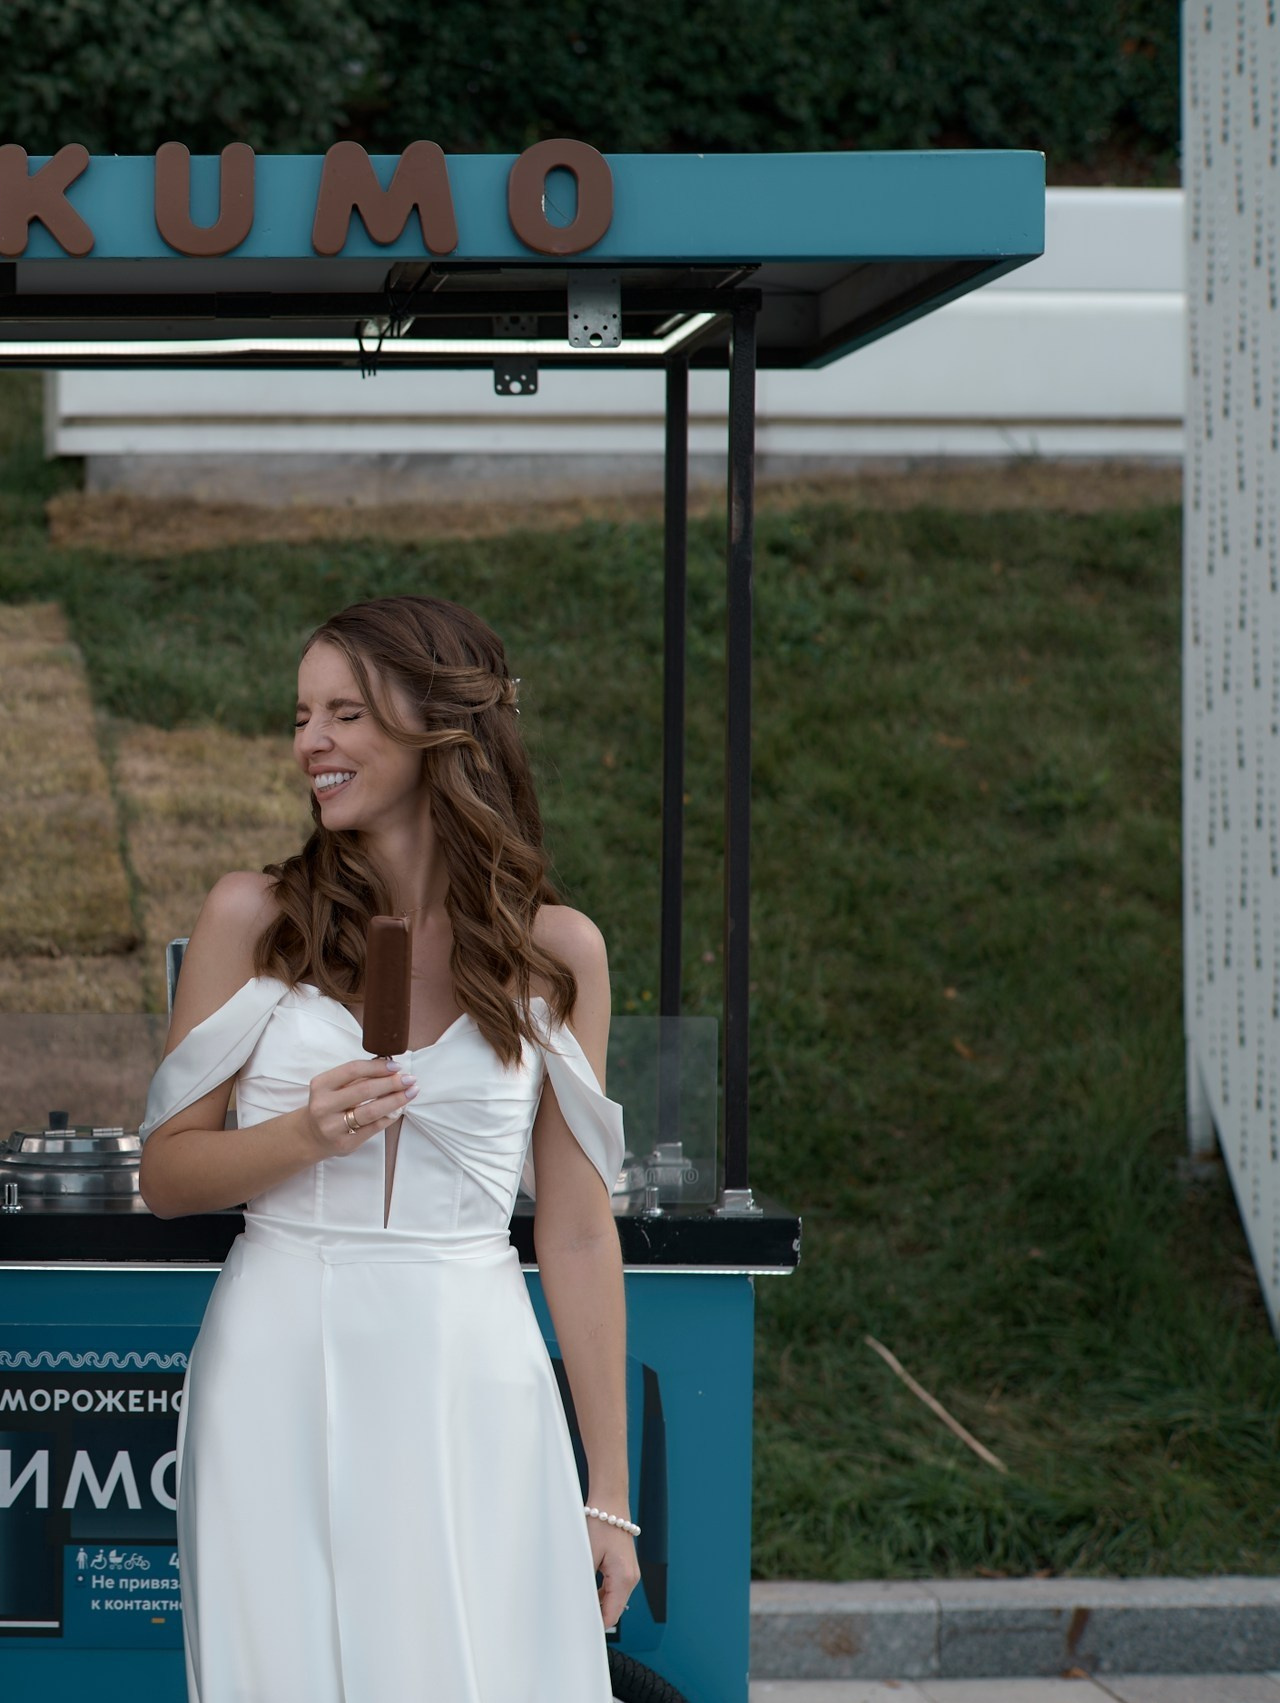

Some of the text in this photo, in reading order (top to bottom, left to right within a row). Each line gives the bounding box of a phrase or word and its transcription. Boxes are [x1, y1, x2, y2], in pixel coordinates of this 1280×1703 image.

[91, 1575, 115, 1589] Не
[91, 1599, 183, 1611] к контактн
